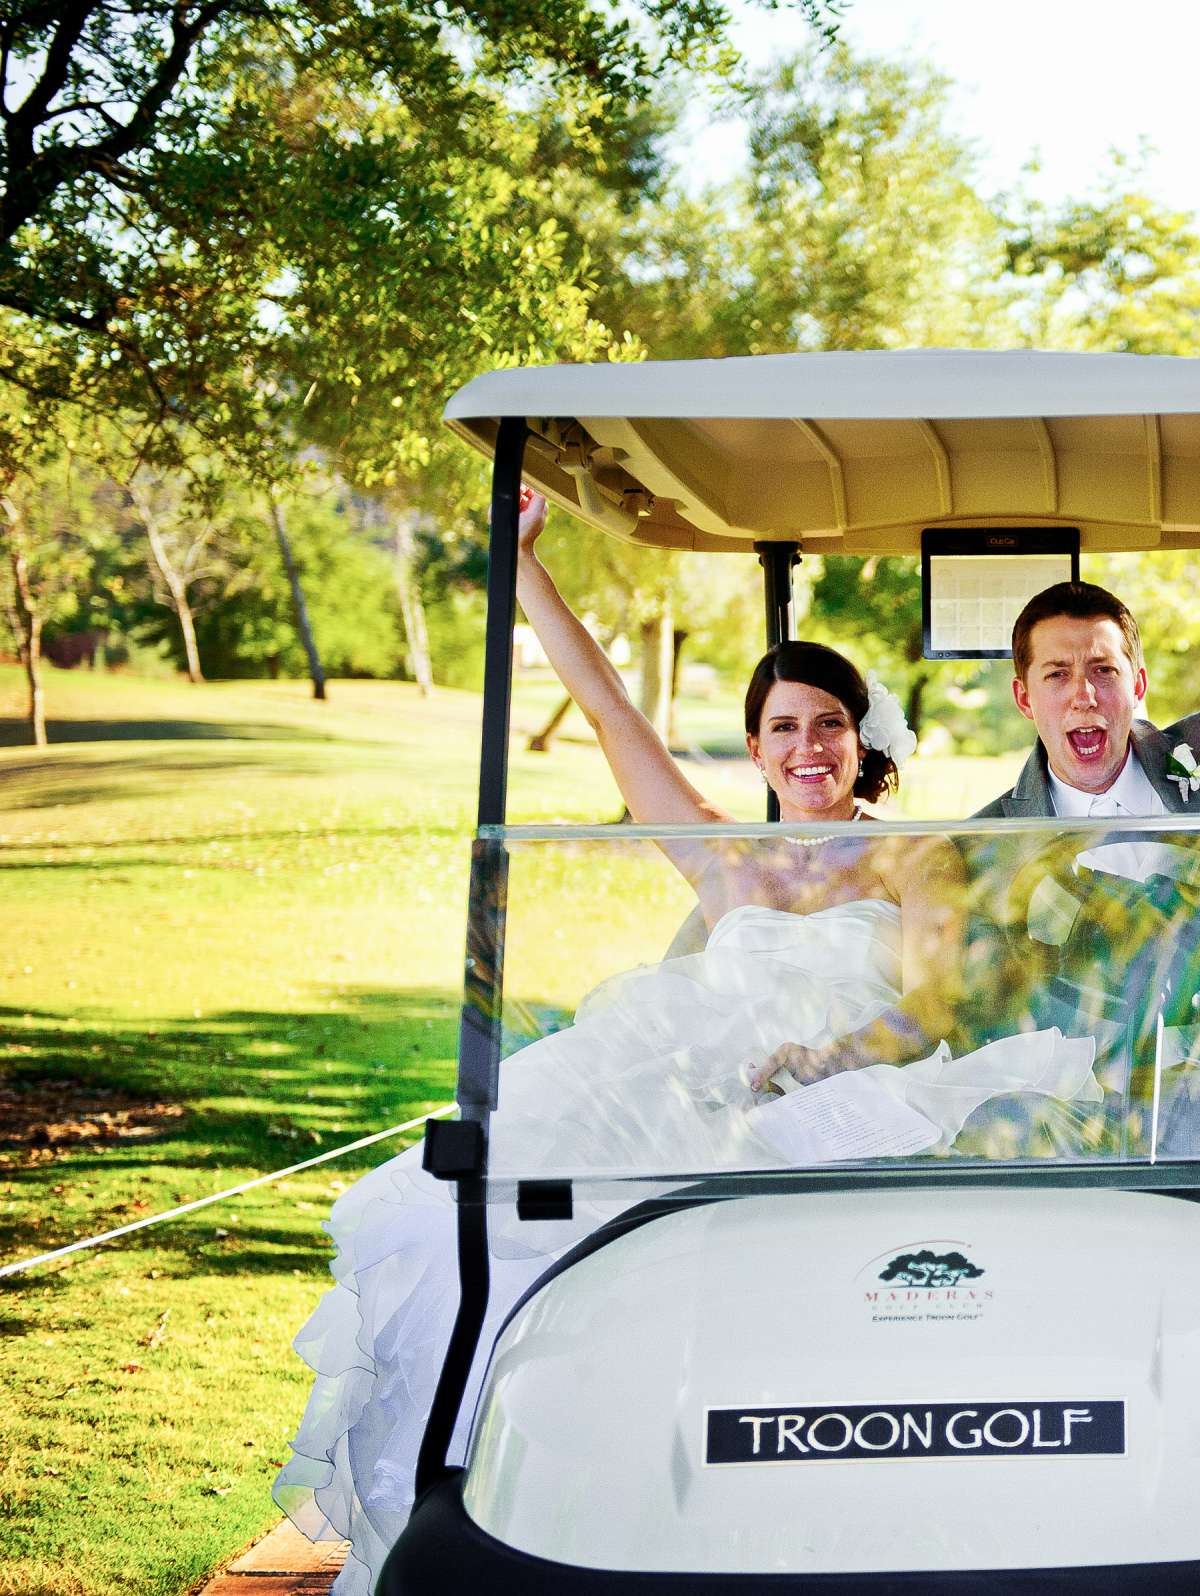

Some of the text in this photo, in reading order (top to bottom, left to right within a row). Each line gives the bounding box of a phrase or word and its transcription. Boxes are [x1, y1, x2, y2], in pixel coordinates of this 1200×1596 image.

[865, 1290, 993, 1301] MADERAS
[739, 1409, 1093, 1455] TROON GOLF
